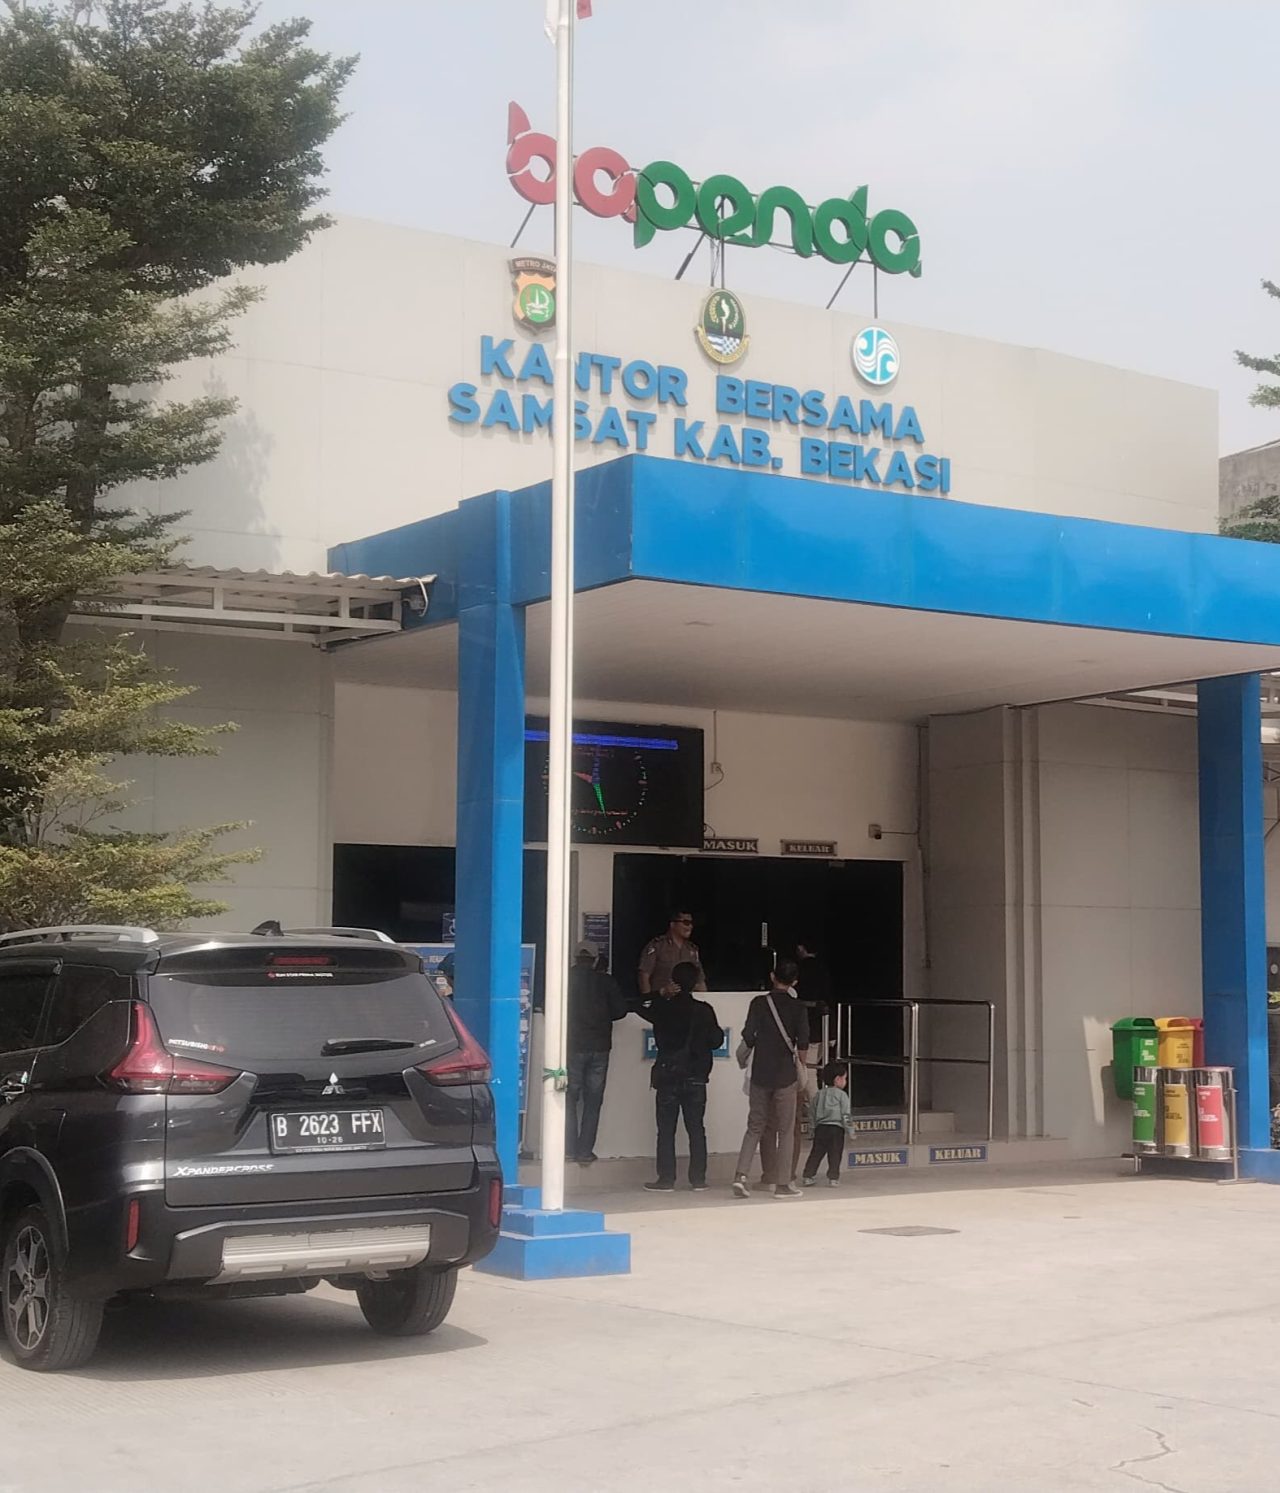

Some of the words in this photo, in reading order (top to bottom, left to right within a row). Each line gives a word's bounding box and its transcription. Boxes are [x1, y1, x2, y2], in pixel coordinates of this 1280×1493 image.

[480, 334, 688, 407] KANTOR
[716, 374, 924, 444] BERSAMA
[448, 382, 657, 450] SAMSAT
[674, 418, 784, 470] KAB.
[801, 437, 950, 494] BEKASI
[703, 839, 758, 852] MASUK
[276, 1116, 287, 1137] B
[299, 1114, 340, 1136] 2623
[351, 1112, 382, 1133] FFX
[852, 1119, 897, 1131] KELUAR
[855, 1152, 901, 1165] MASUK
[935, 1148, 981, 1160] KELUAR
